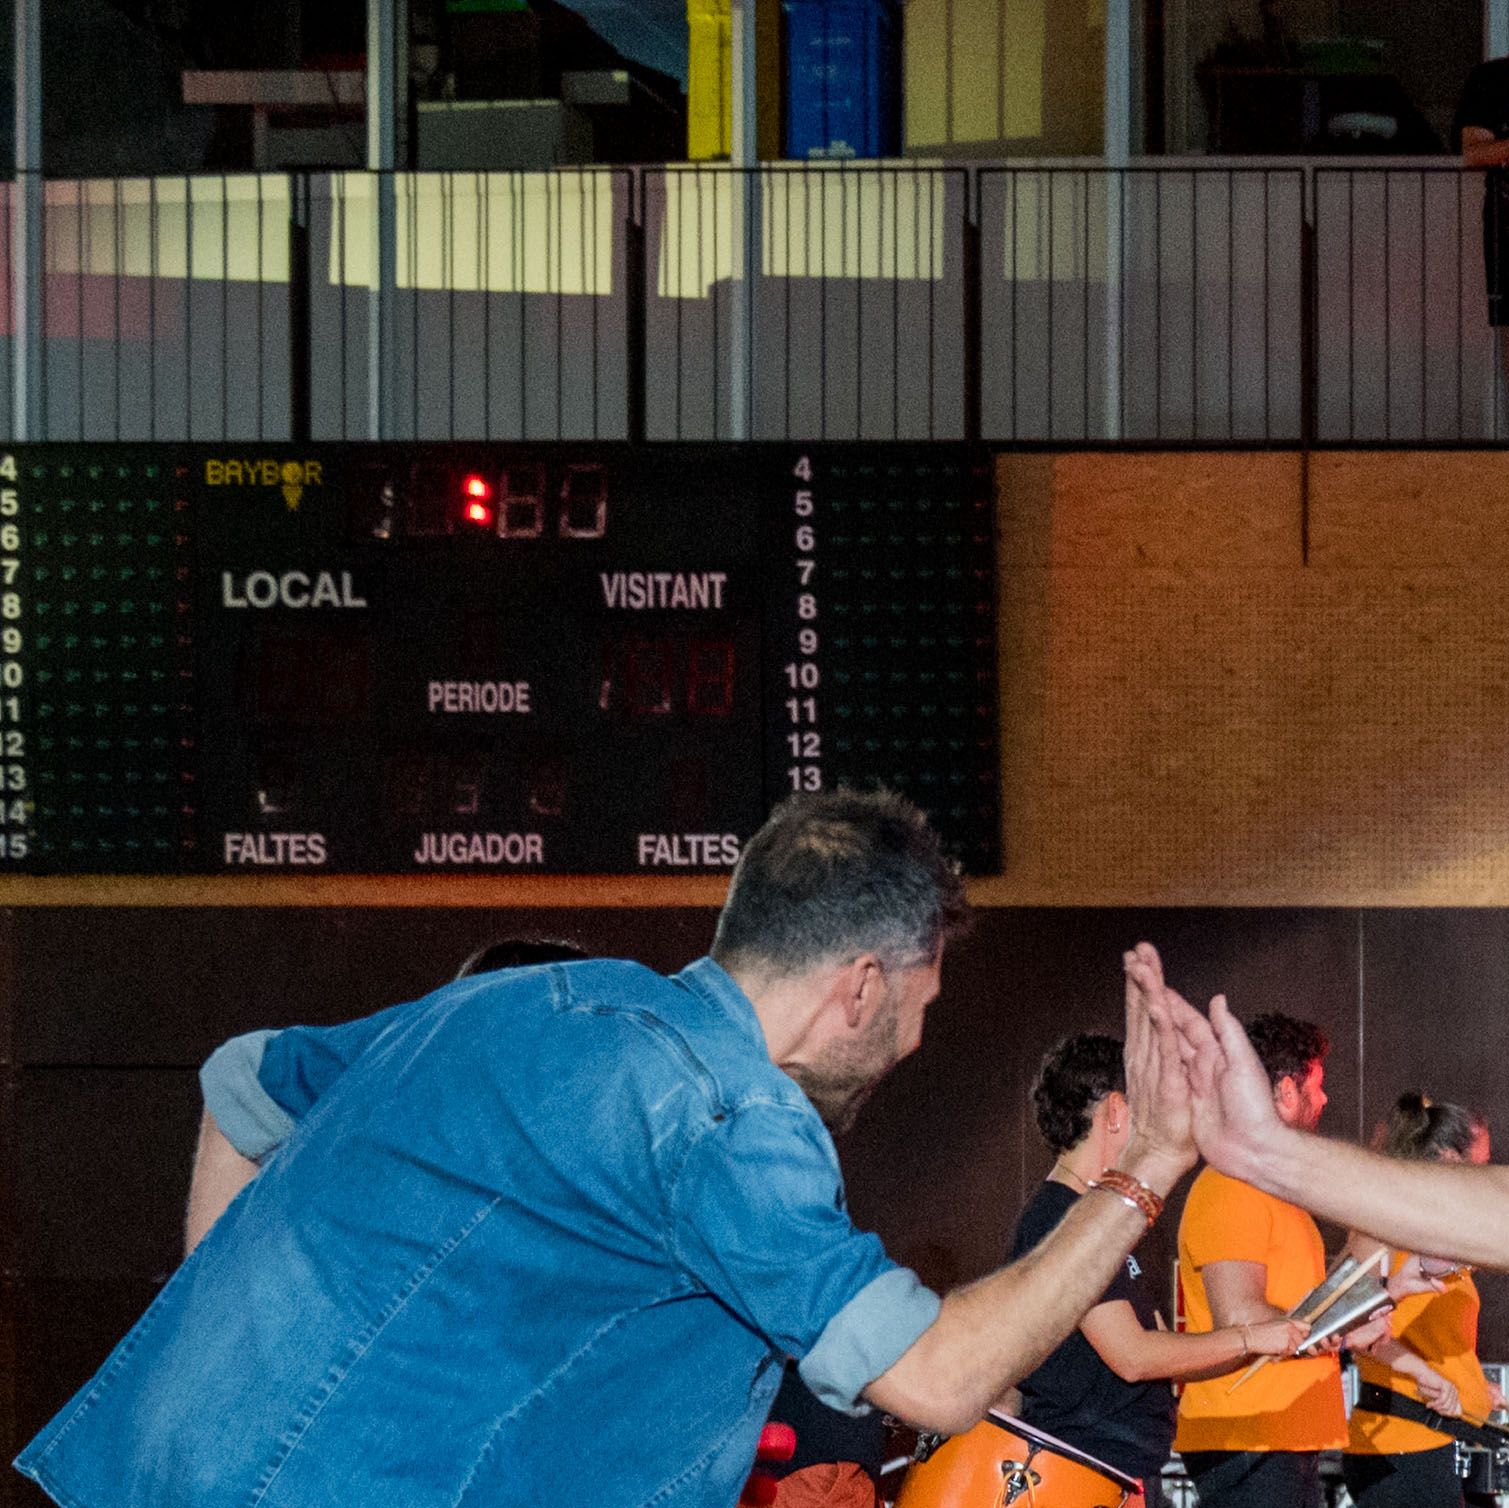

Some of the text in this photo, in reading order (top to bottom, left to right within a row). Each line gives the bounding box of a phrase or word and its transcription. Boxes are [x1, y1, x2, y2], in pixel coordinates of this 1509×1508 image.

[0, 455, 18, 481] 4
[794, 457, 813, 481] 4
[0, 489, 19, 516] 5
[796, 491, 814, 516] 5
[1, 523, 20, 550] 6
[796, 526, 815, 551] 6
[1, 558, 20, 585] 7
[797, 560, 816, 585] 7
[221, 571, 368, 609] LOCAL
[600, 572, 728, 609] VISITANT
[2, 592, 21, 620] 8
[798, 594, 817, 620] 8
[3, 626, 22, 654] 9
[799, 628, 818, 654] 9
[0, 661, 23, 688] 0
[785, 663, 819, 689] 10
[0, 697, 20, 722] 1
[428, 681, 531, 713] PERIODE
[786, 697, 817, 724] 11
[787, 732, 821, 758] 12
[788, 766, 822, 792] 13
[224, 833, 327, 865] FALTES
[414, 833, 544, 865] JUGADOR
[638, 833, 740, 866] FALTES
